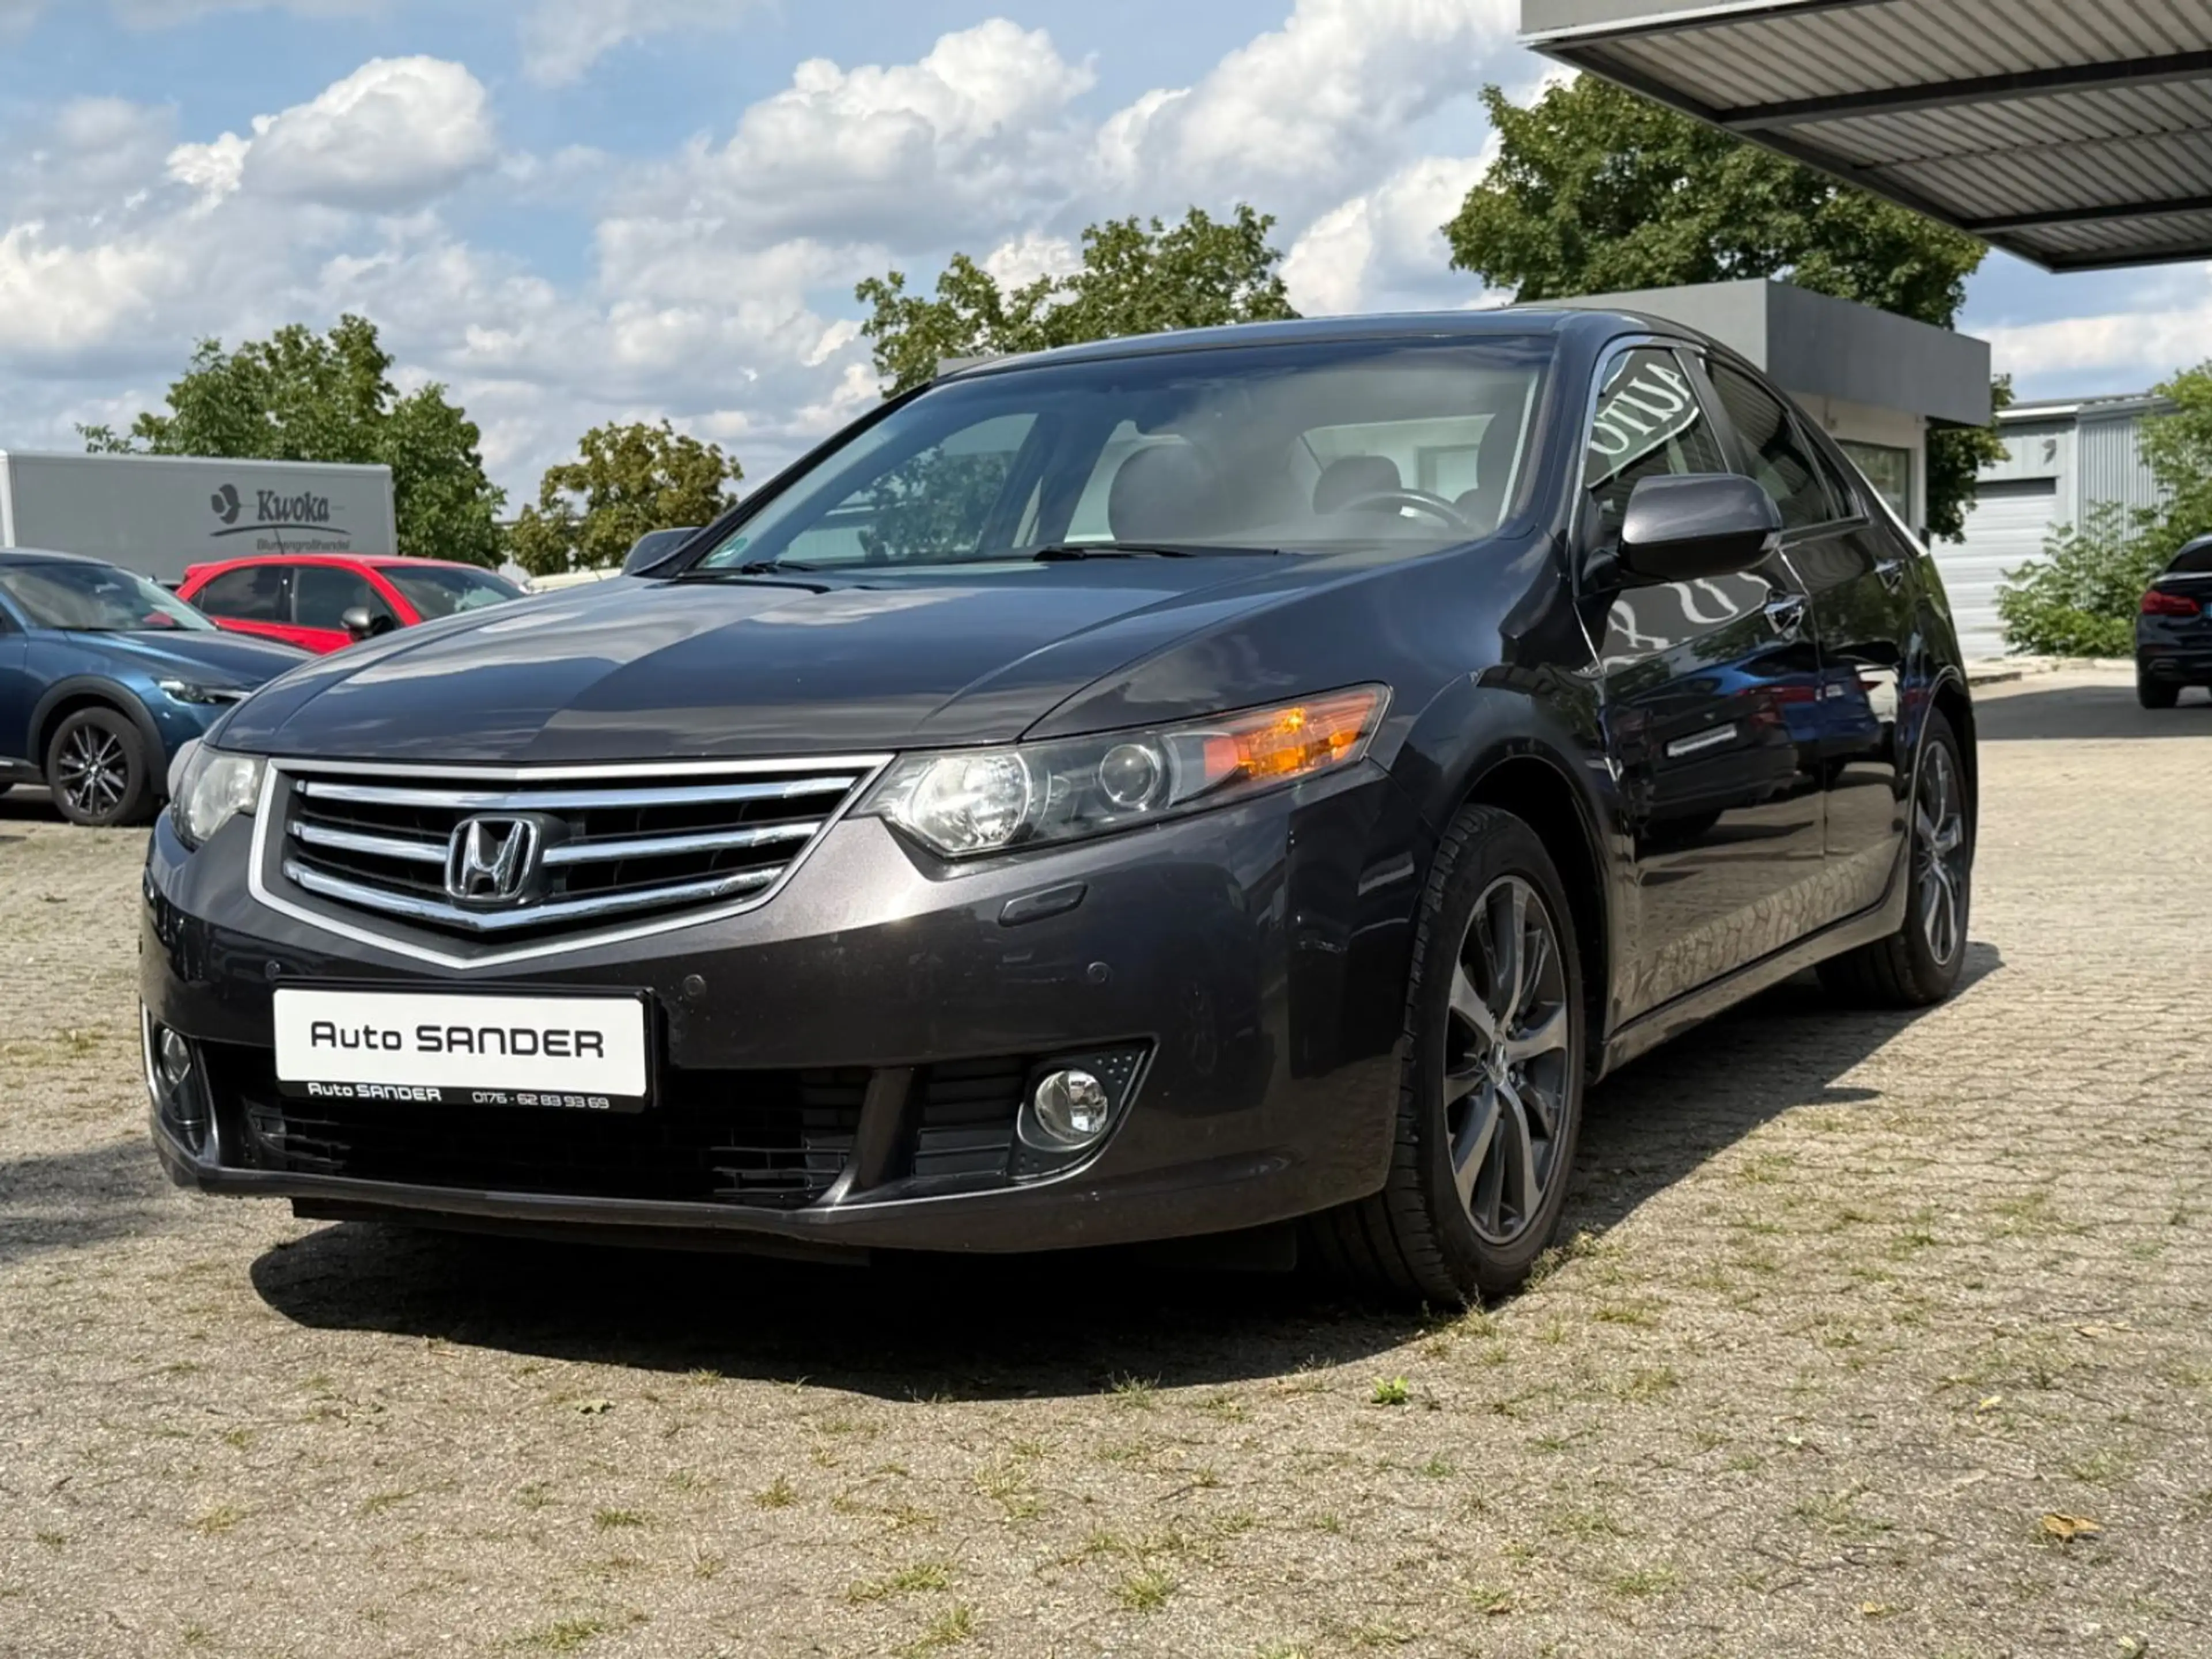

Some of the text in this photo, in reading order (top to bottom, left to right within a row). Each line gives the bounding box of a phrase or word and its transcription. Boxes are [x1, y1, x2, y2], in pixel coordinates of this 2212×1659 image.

[256, 490, 330, 522] Kwoka
[310, 1021, 604, 1058] Auto SANDER
[308, 1082, 354, 1097] Auto
[355, 1084, 442, 1102] SANDER
[472, 1091, 507, 1104] 0176
[516, 1093, 539, 1106] 62
[563, 1095, 586, 1108] 93
[587, 1096, 610, 1109] 69
